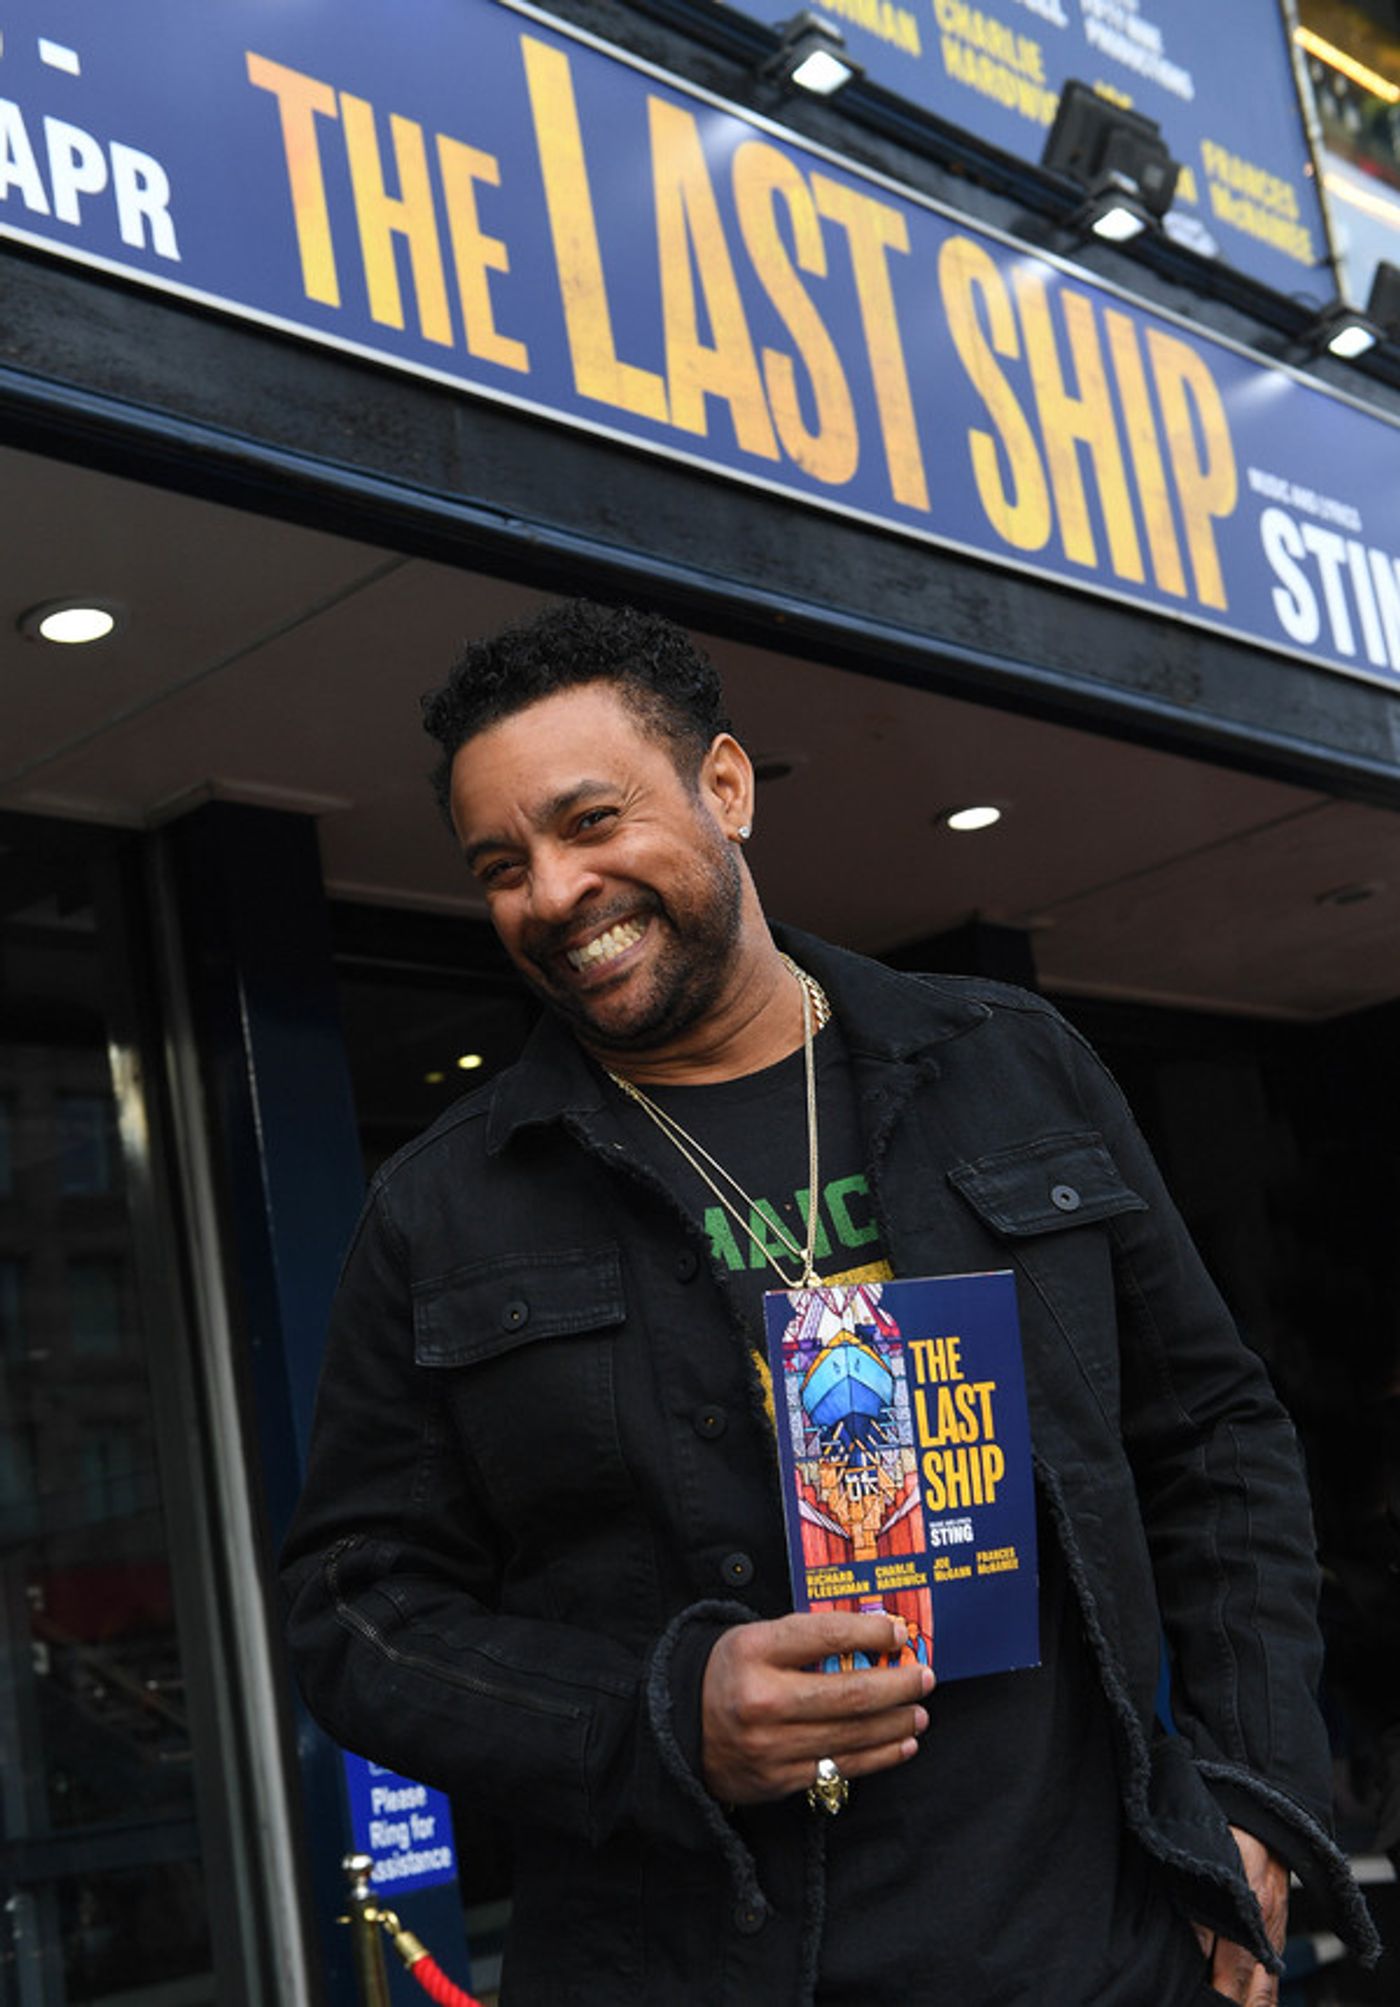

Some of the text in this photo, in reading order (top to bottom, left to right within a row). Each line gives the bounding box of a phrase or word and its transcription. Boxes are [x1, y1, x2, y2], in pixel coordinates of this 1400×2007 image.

[0, 97, 181, 262] APR
[246, 33, 1238, 611] THE LAST SHIP
[907, 1336, 965, 1385] THE
[914, 1381, 996, 1448] LAST
[922, 1444, 1005, 1512] SHIP
[930, 1523, 974, 1548] STING
[806, 1570, 854, 1586] RICHARD
[875, 1561, 916, 1577] CHARLIE
[370, 1784, 428, 1816] Please
[369, 1813, 436, 1850] Ring for
[370, 1846, 452, 1884] ssistance
